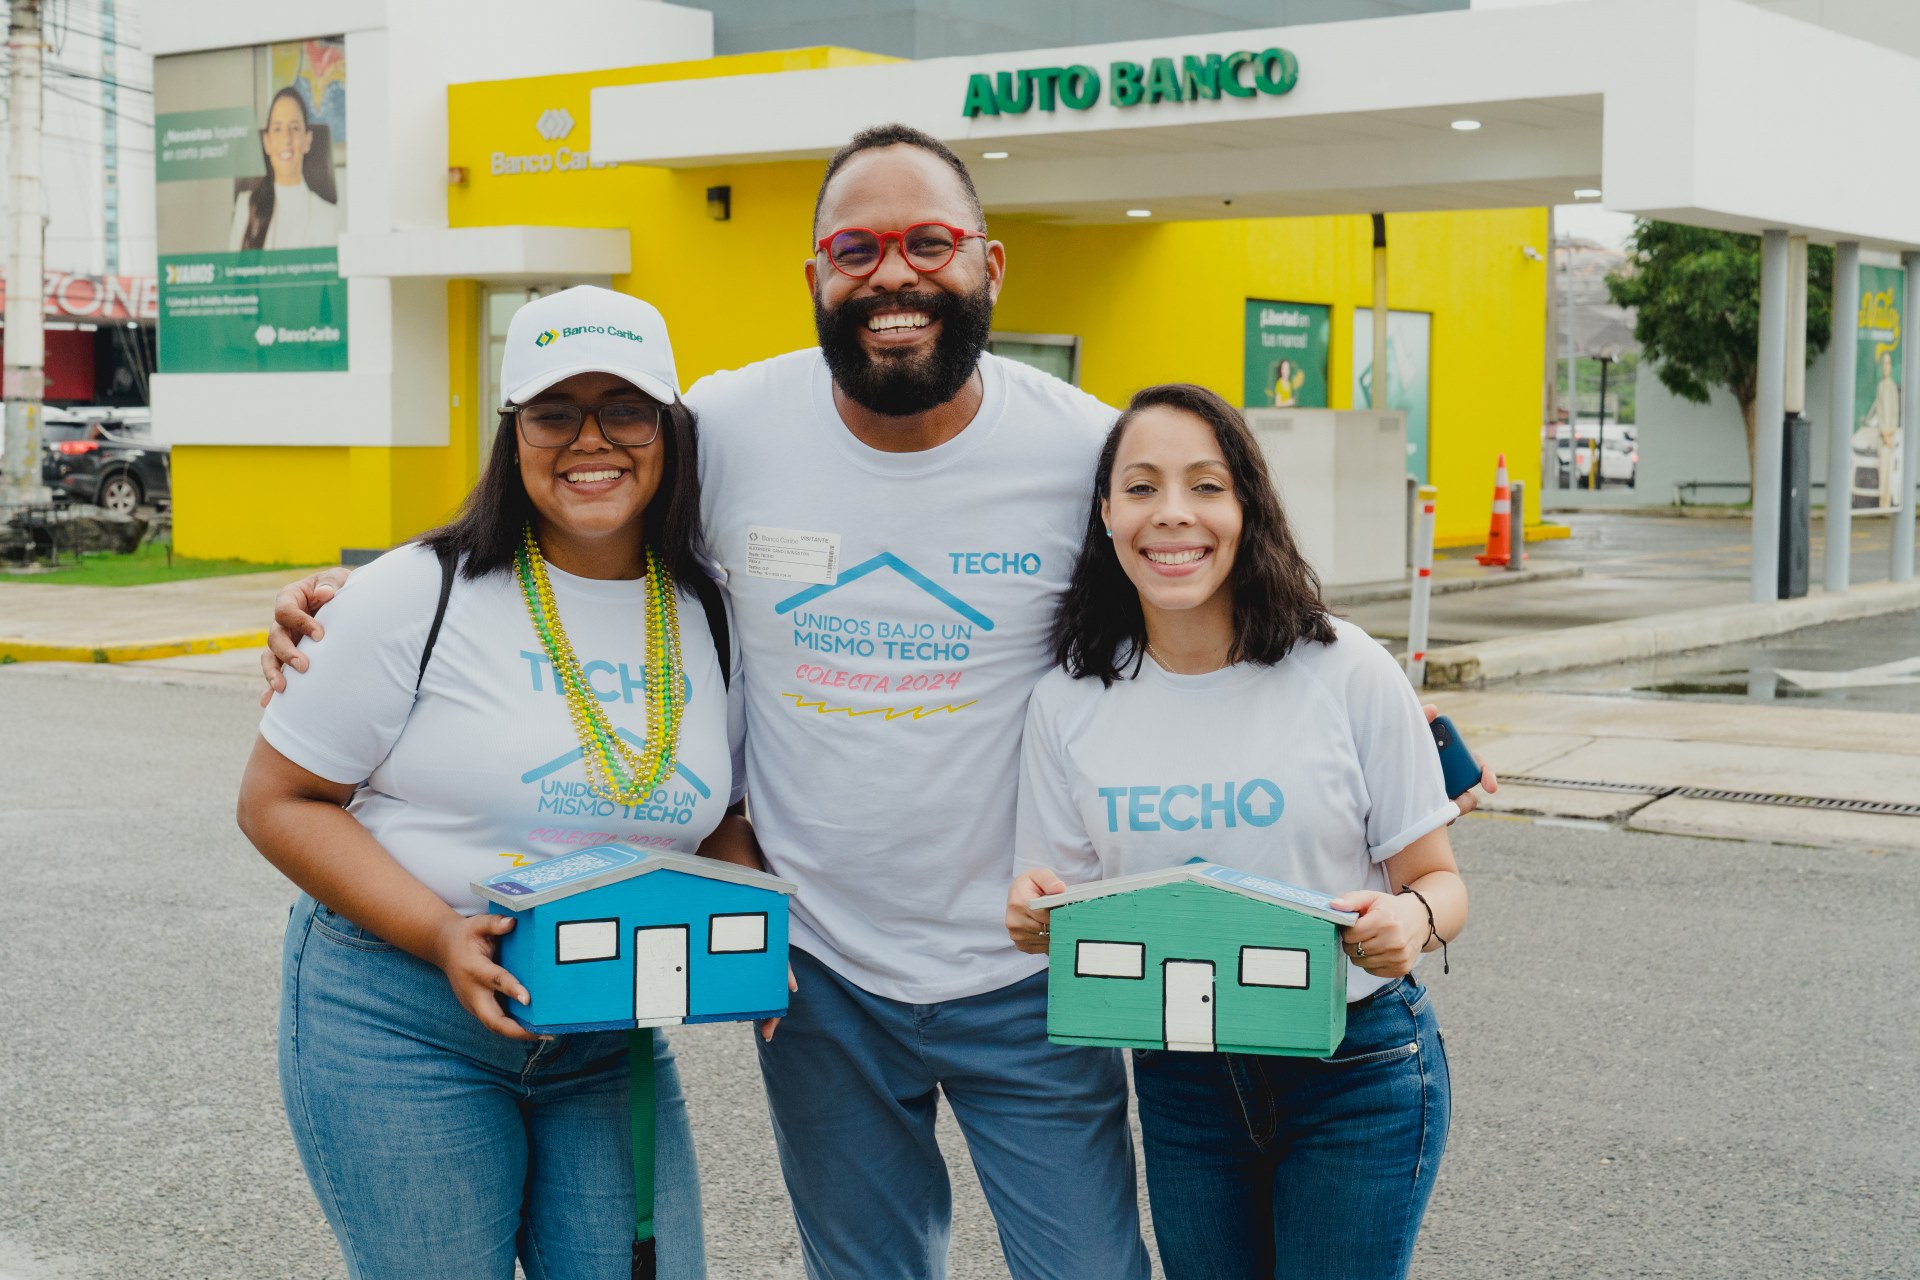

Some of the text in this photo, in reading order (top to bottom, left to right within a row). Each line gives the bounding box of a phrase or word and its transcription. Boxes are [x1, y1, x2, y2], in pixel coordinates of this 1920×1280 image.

[962, 47, 1299, 118] AUTO BANCO
[490, 147, 619, 176] Banco Car
[277, 326, 340, 343] Banco Caribe
[562, 325, 643, 343] Banco Caribe
[761, 535, 829, 545] Banco Caribe VISITANTE
[948, 552, 1041, 576] TECHO
[794, 611, 972, 641] UNIDOS BAJO UN
[794, 629, 970, 662] MISMO TECHO
[520, 650, 693, 707] TCH
[795, 663, 963, 693] COLECTA 2024
[538, 795, 693, 825] MISMO TECHO
[673, 790, 698, 808] UN
[1098, 778, 1285, 833] TECHO
